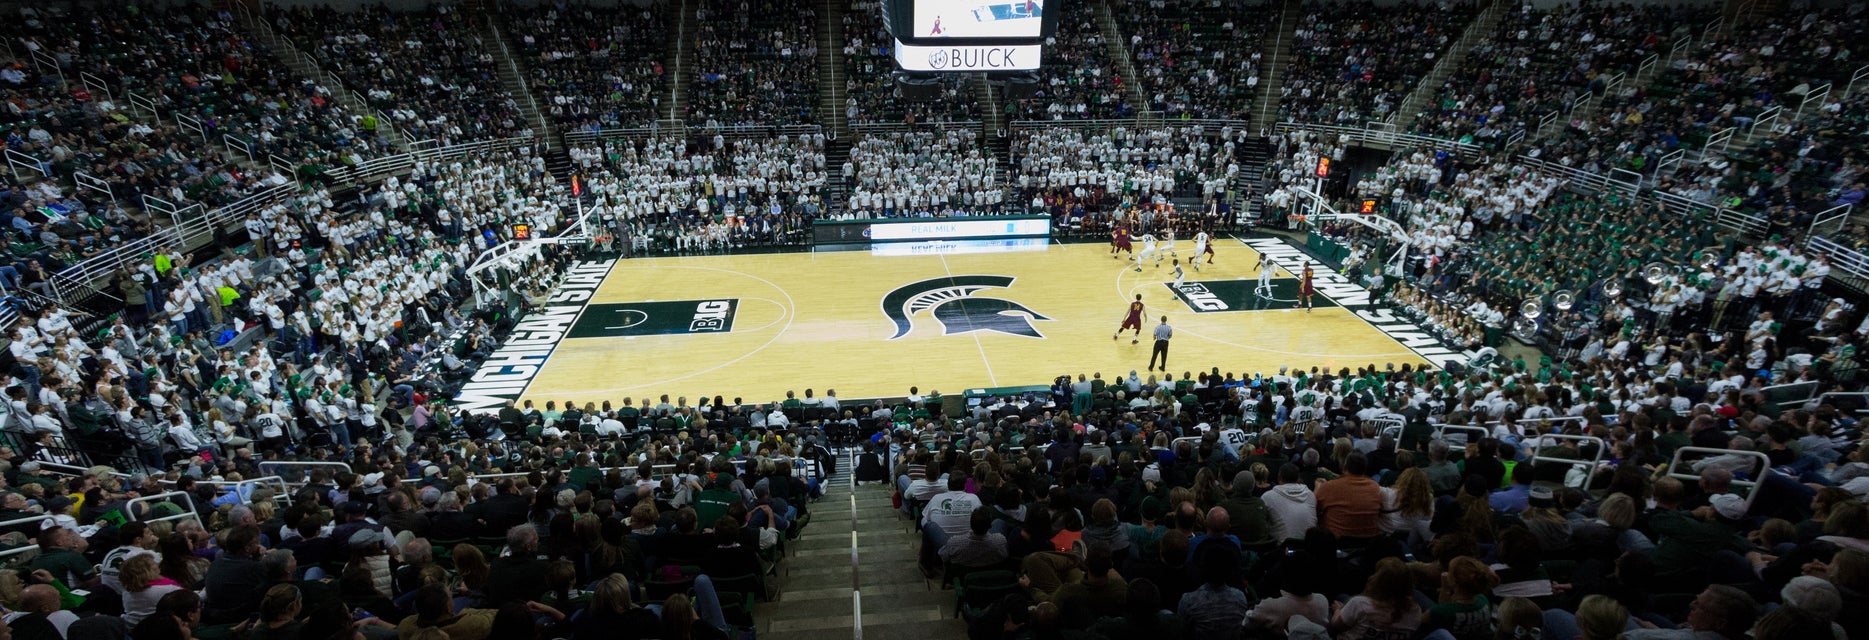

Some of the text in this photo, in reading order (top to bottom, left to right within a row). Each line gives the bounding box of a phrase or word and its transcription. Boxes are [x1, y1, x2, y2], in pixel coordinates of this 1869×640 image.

[952, 48, 1015, 67] BUICK
[936, 224, 957, 233] MILK
[1240, 237, 1382, 305] MICHIGAN
[449, 305, 583, 417] MICHIGAN
[1300, 410, 1312, 419] 20
[259, 417, 273, 427] 20
[1228, 432, 1244, 444] 20
